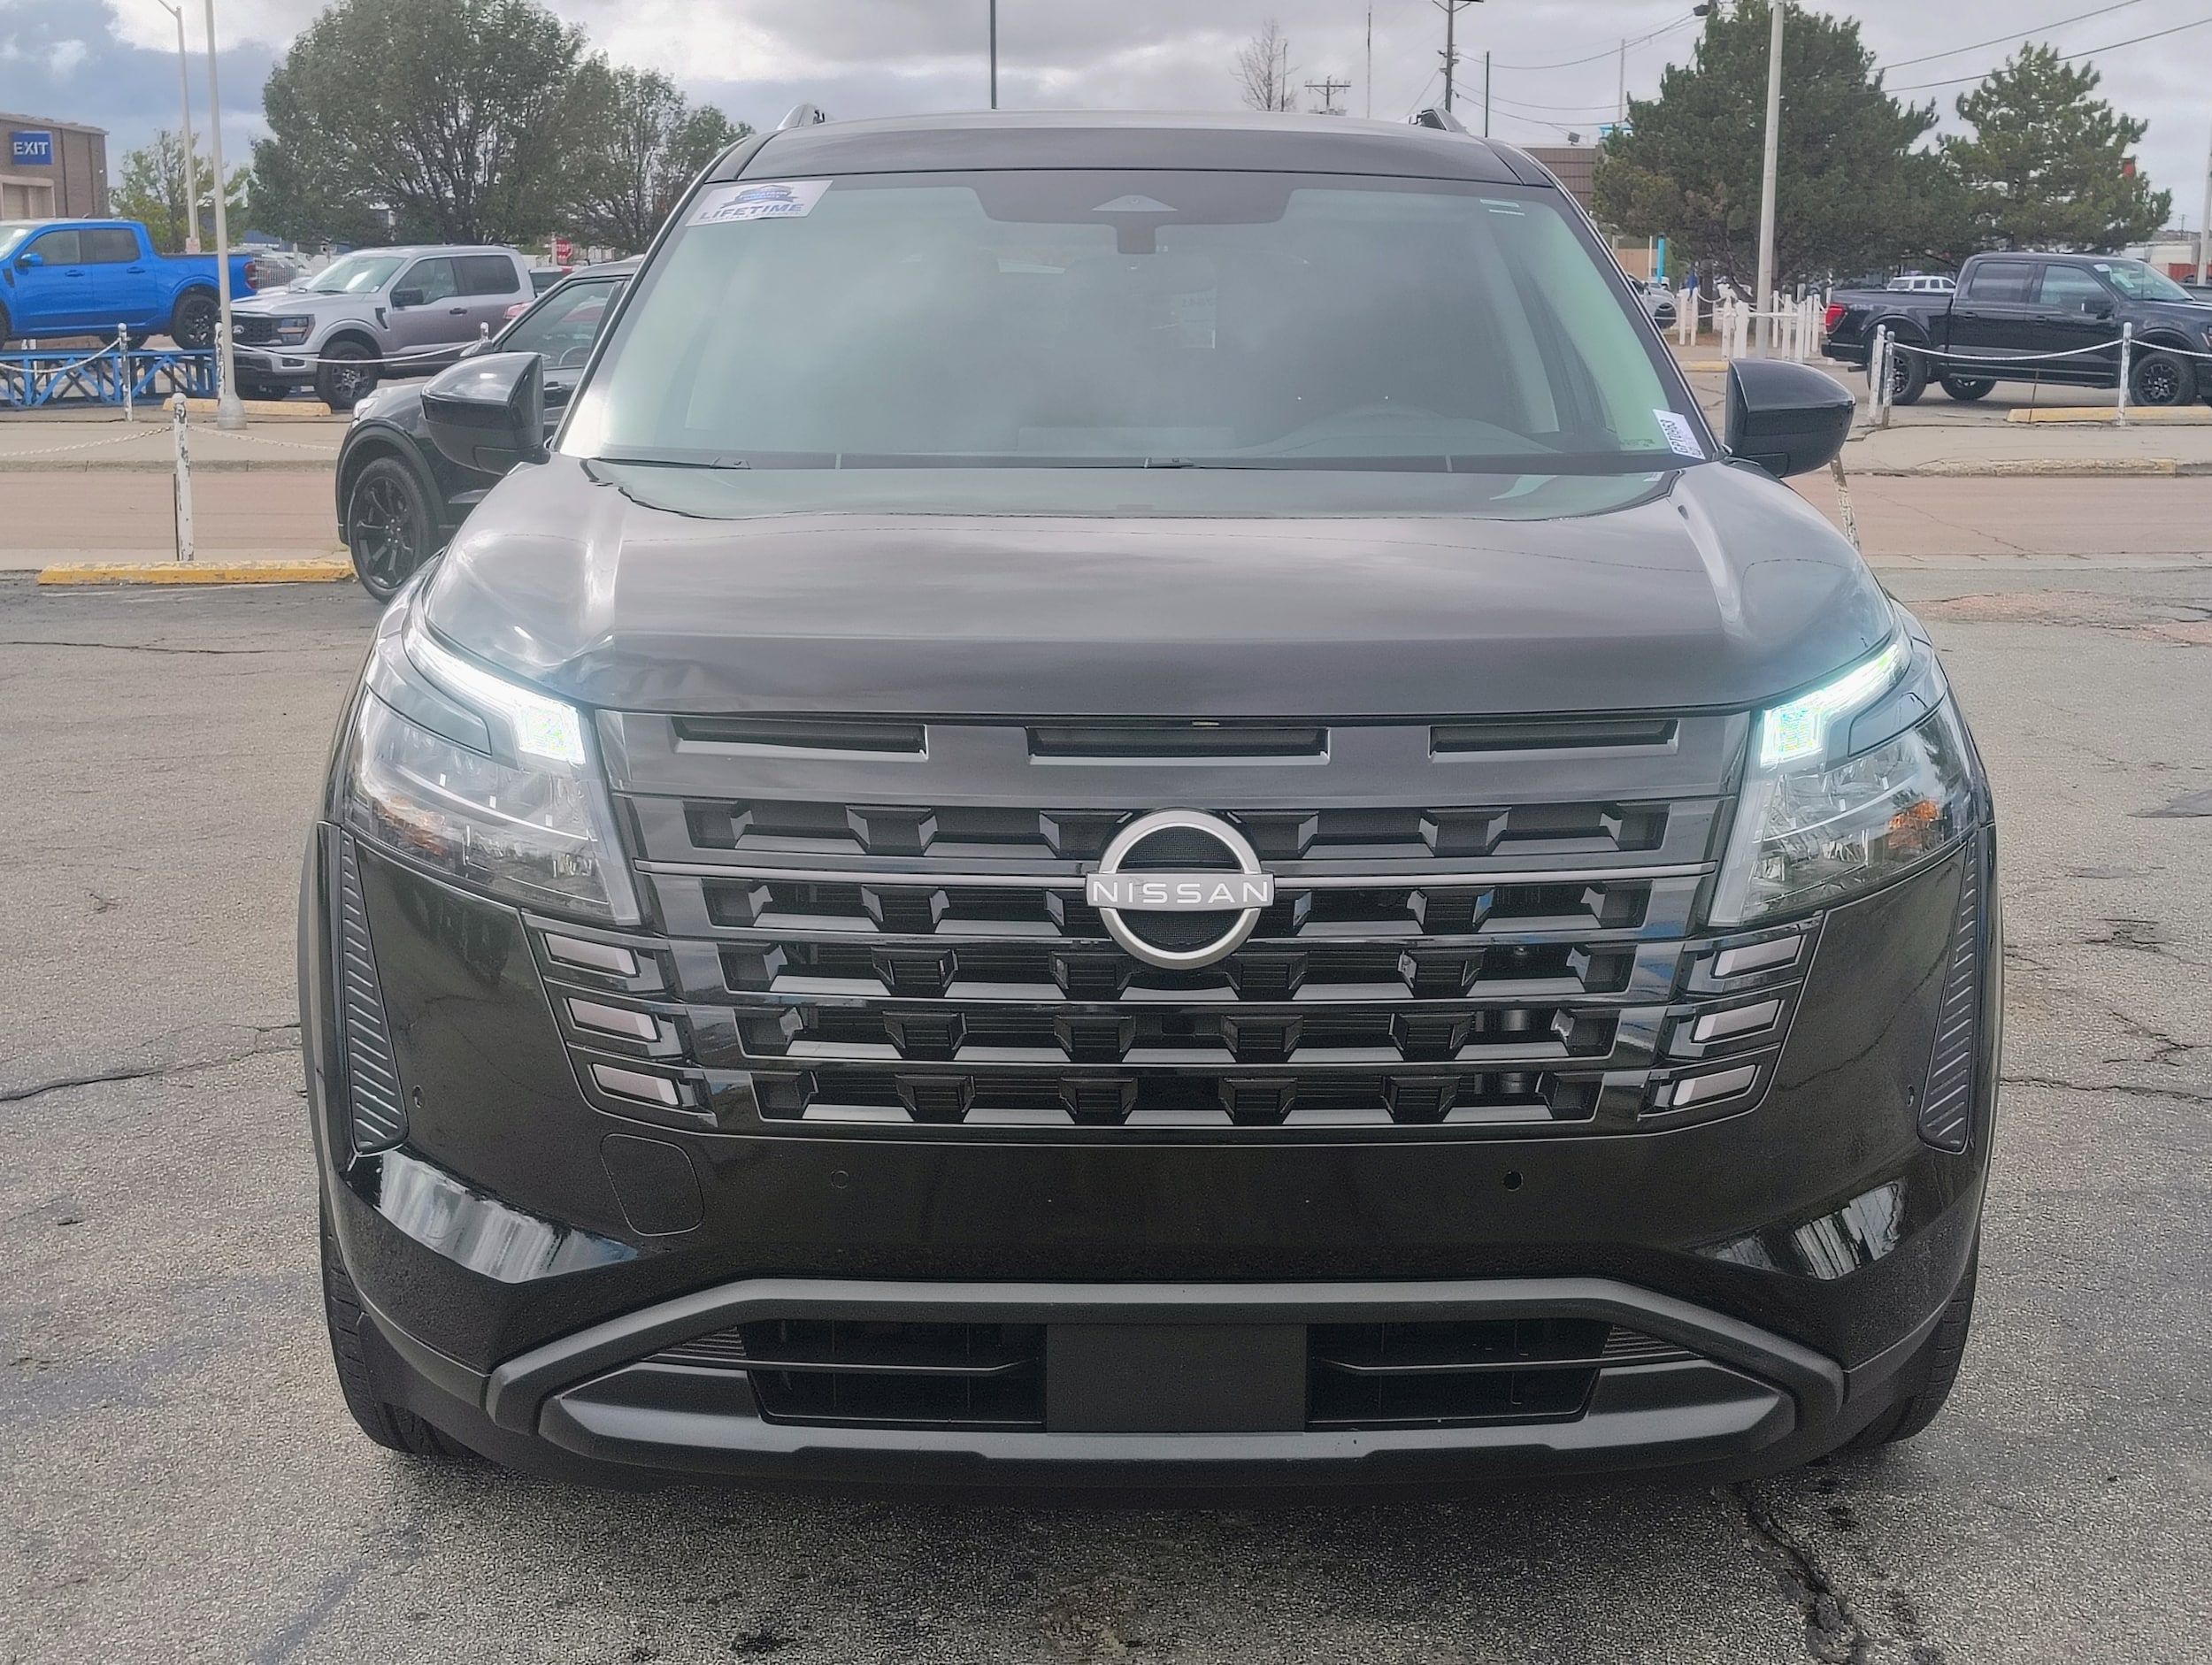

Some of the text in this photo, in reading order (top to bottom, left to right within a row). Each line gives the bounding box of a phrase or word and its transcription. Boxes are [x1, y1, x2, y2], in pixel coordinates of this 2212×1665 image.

[13, 141, 49, 156] EXIT
[699, 203, 804, 220] LIFETIME
[556, 242, 572, 253] TOP
[1092, 881, 1269, 904] NISSAN
